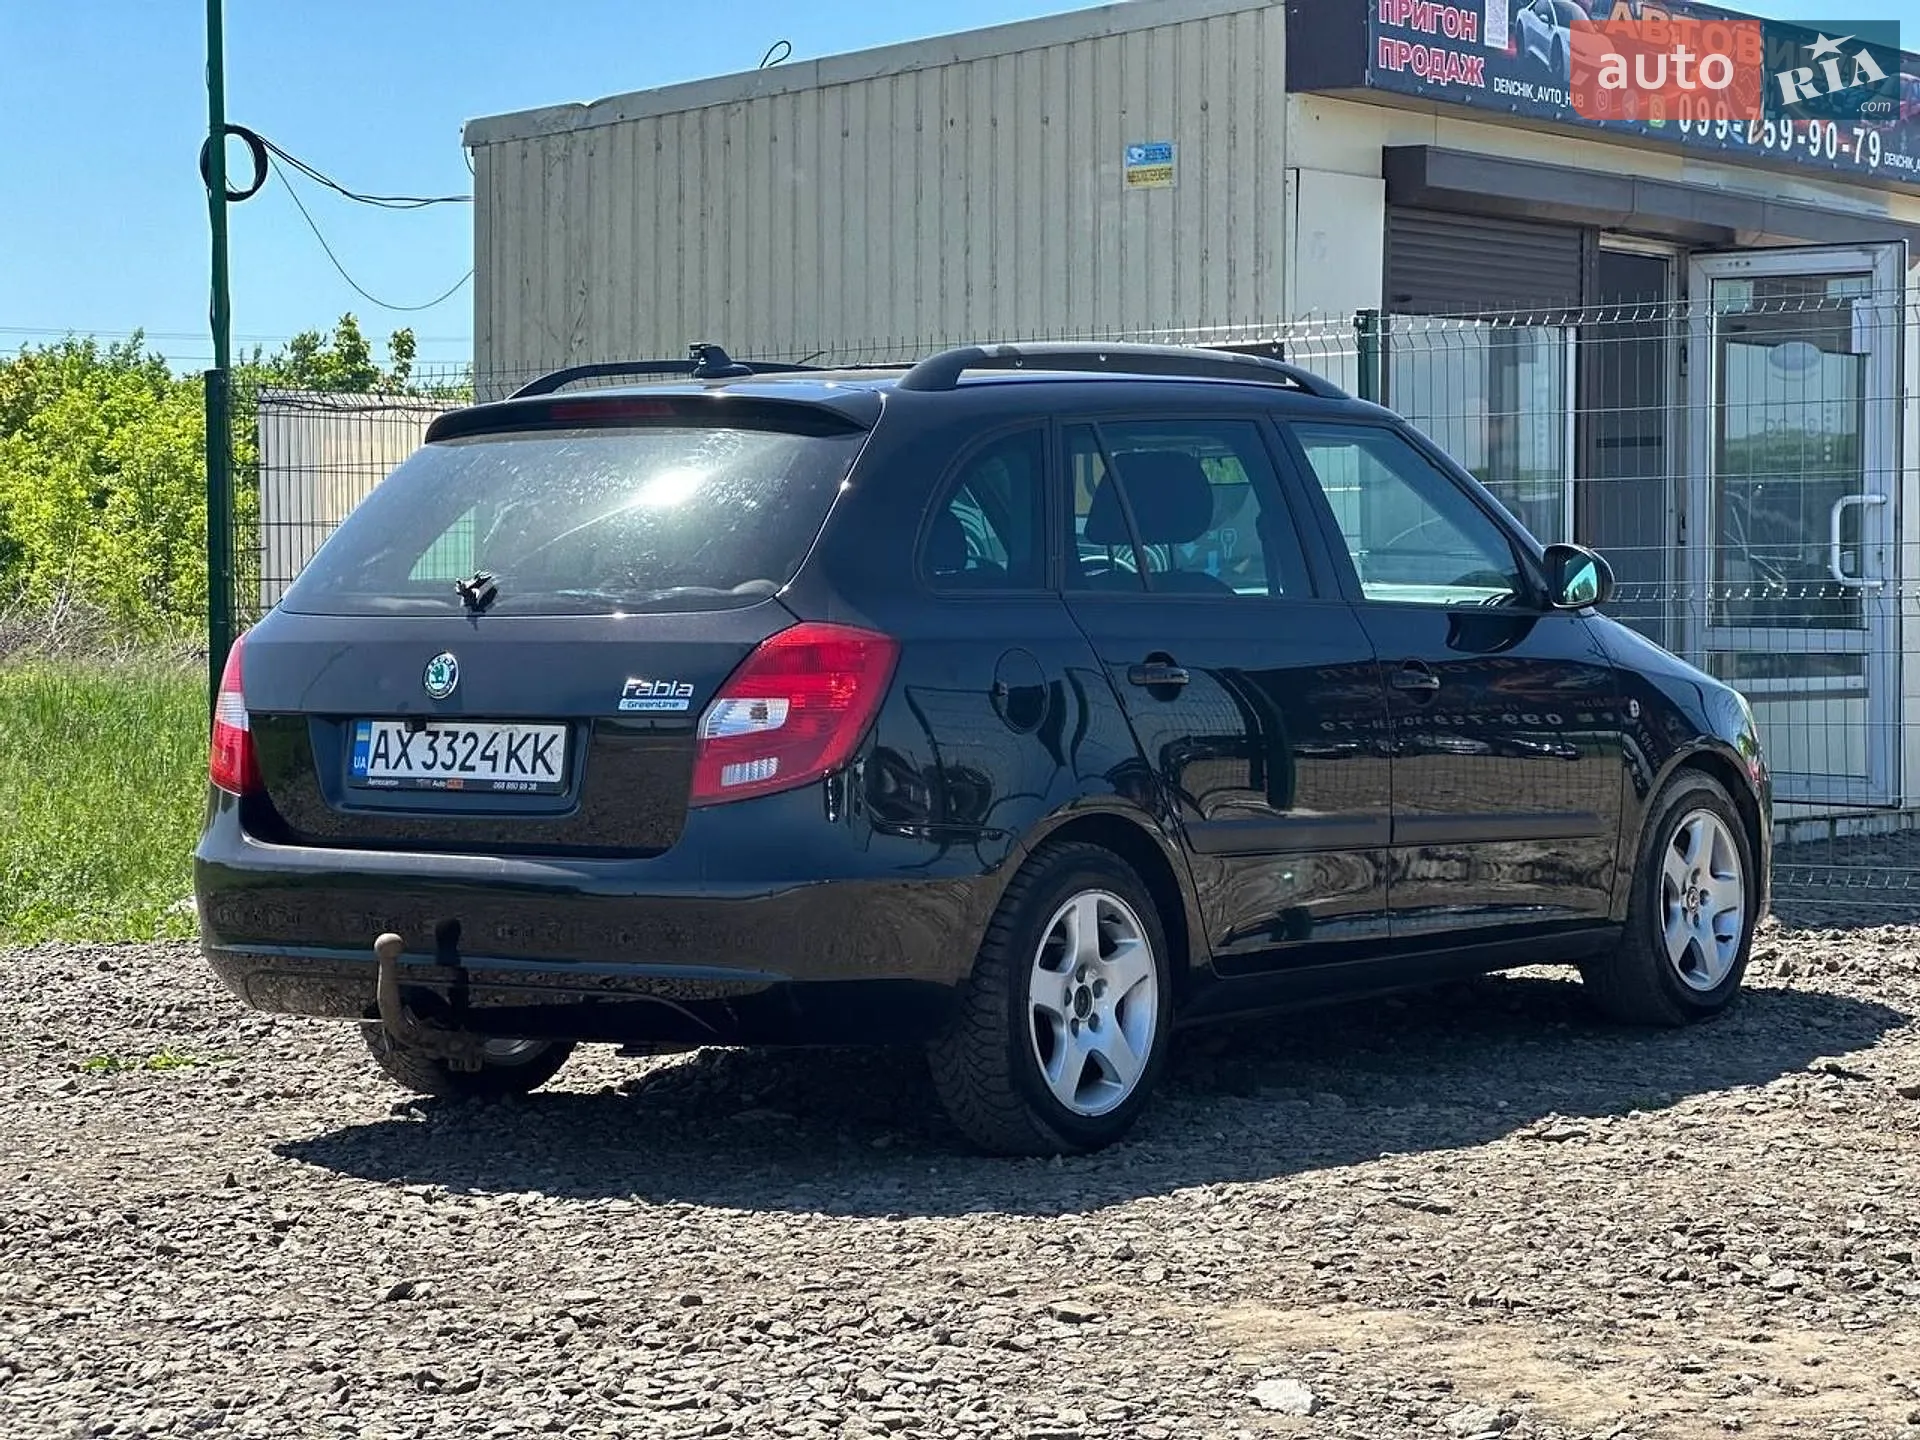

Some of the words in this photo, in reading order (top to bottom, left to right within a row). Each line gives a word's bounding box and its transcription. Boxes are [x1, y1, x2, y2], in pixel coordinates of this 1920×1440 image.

[1379, 0, 1477, 42] ПРИГОН
[1379, 37, 1485, 88] ПРОДАЖ
[1678, 93, 1881, 168] 099-759-90-79
[622, 678, 694, 697] Fabia
[353, 756, 367, 768] UA
